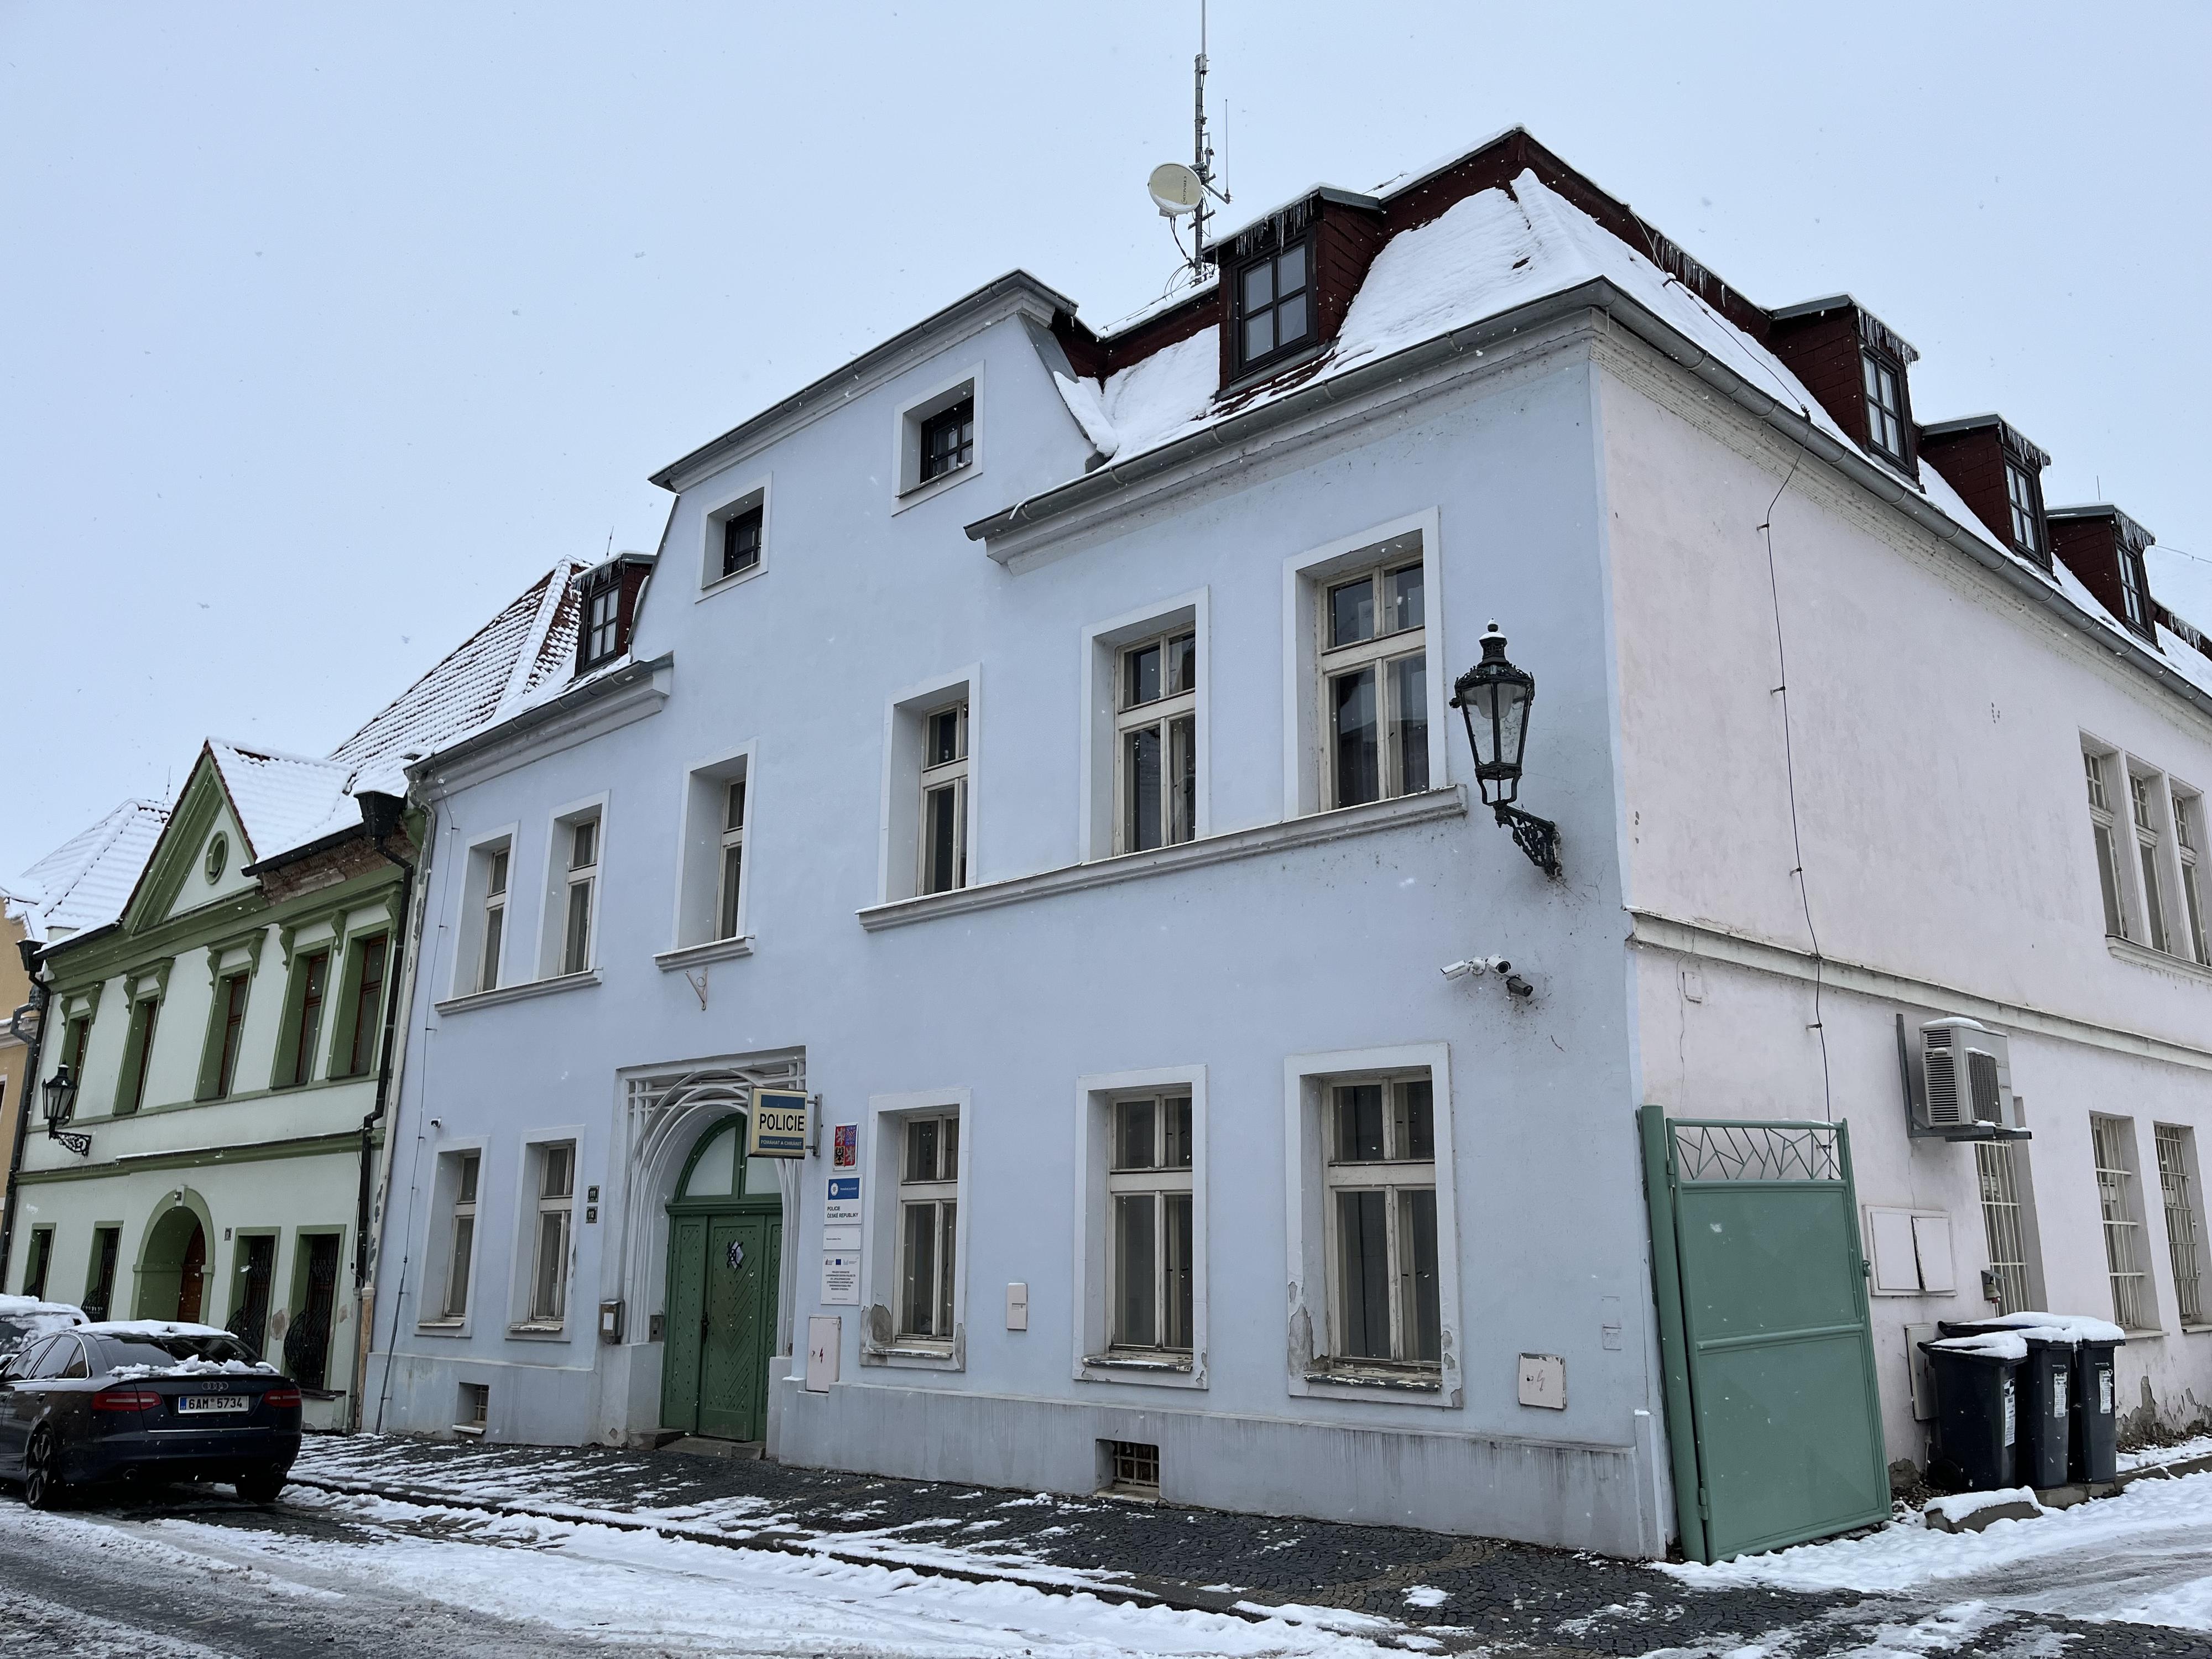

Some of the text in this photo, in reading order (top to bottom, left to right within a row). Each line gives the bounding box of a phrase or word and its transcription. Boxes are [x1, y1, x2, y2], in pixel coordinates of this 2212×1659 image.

[759, 1113, 805, 1131] POLICIE
[189, 1397, 242, 1410] 6AM 5734
